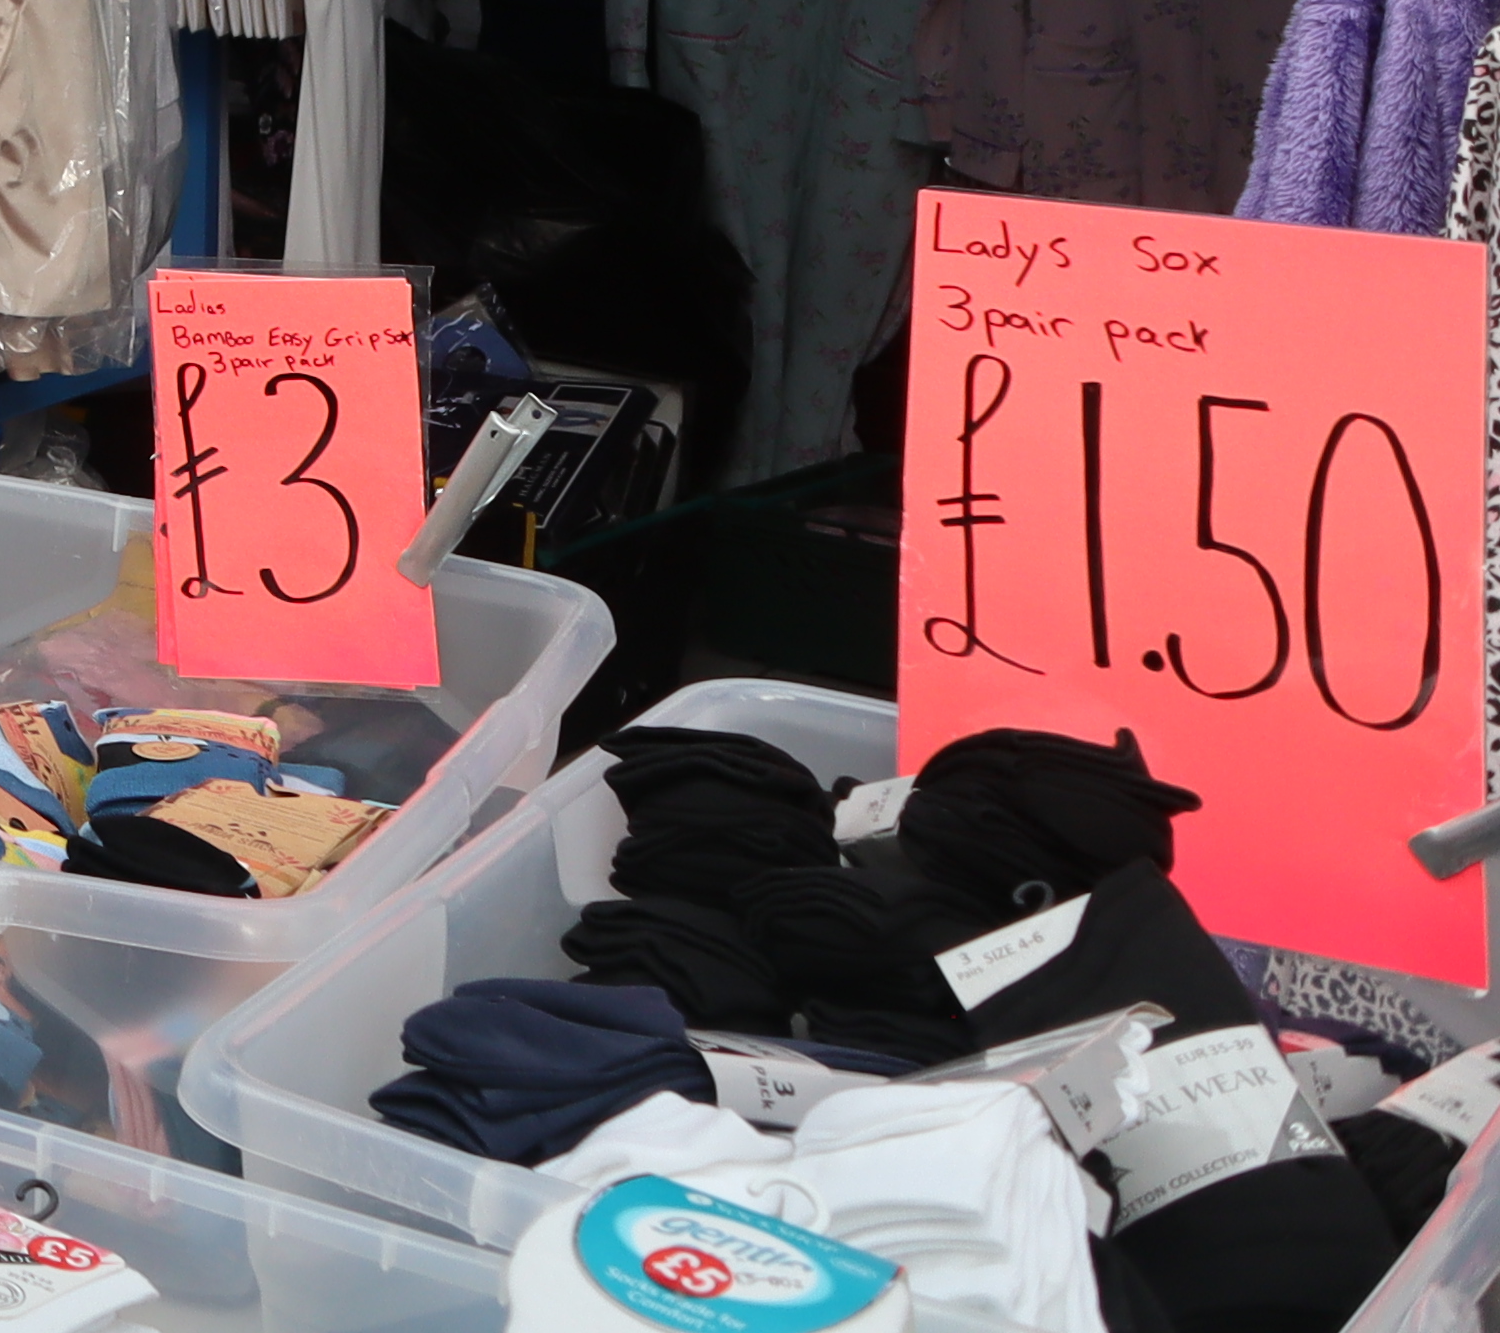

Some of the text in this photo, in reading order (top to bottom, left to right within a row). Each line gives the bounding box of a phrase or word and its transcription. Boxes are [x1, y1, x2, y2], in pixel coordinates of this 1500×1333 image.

[932, 200, 1222, 287] Ladys Sox
[156, 289, 227, 317] Ladies
[1104, 319, 1209, 362] pack
[285, 352, 336, 376] pack
[171, 362, 360, 605] £3
[924, 353, 1442, 731] £1.50
[958, 928, 1045, 967] 3 SIZE 4-6
[1174, 1037, 1255, 1067] EUR 35-39
[752, 1065, 774, 1111] Pack
[774, 1080, 795, 1098] 3
[1180, 1065, 1278, 1105] WEAR
[1288, 1121, 1311, 1141] 3
[1168, 1147, 1261, 1191] COLLECTION
[1118, 1185, 1168, 1222] OTTON
[37, 1240, 98, 1269] £5
[653, 1251, 729, 1294] £5
